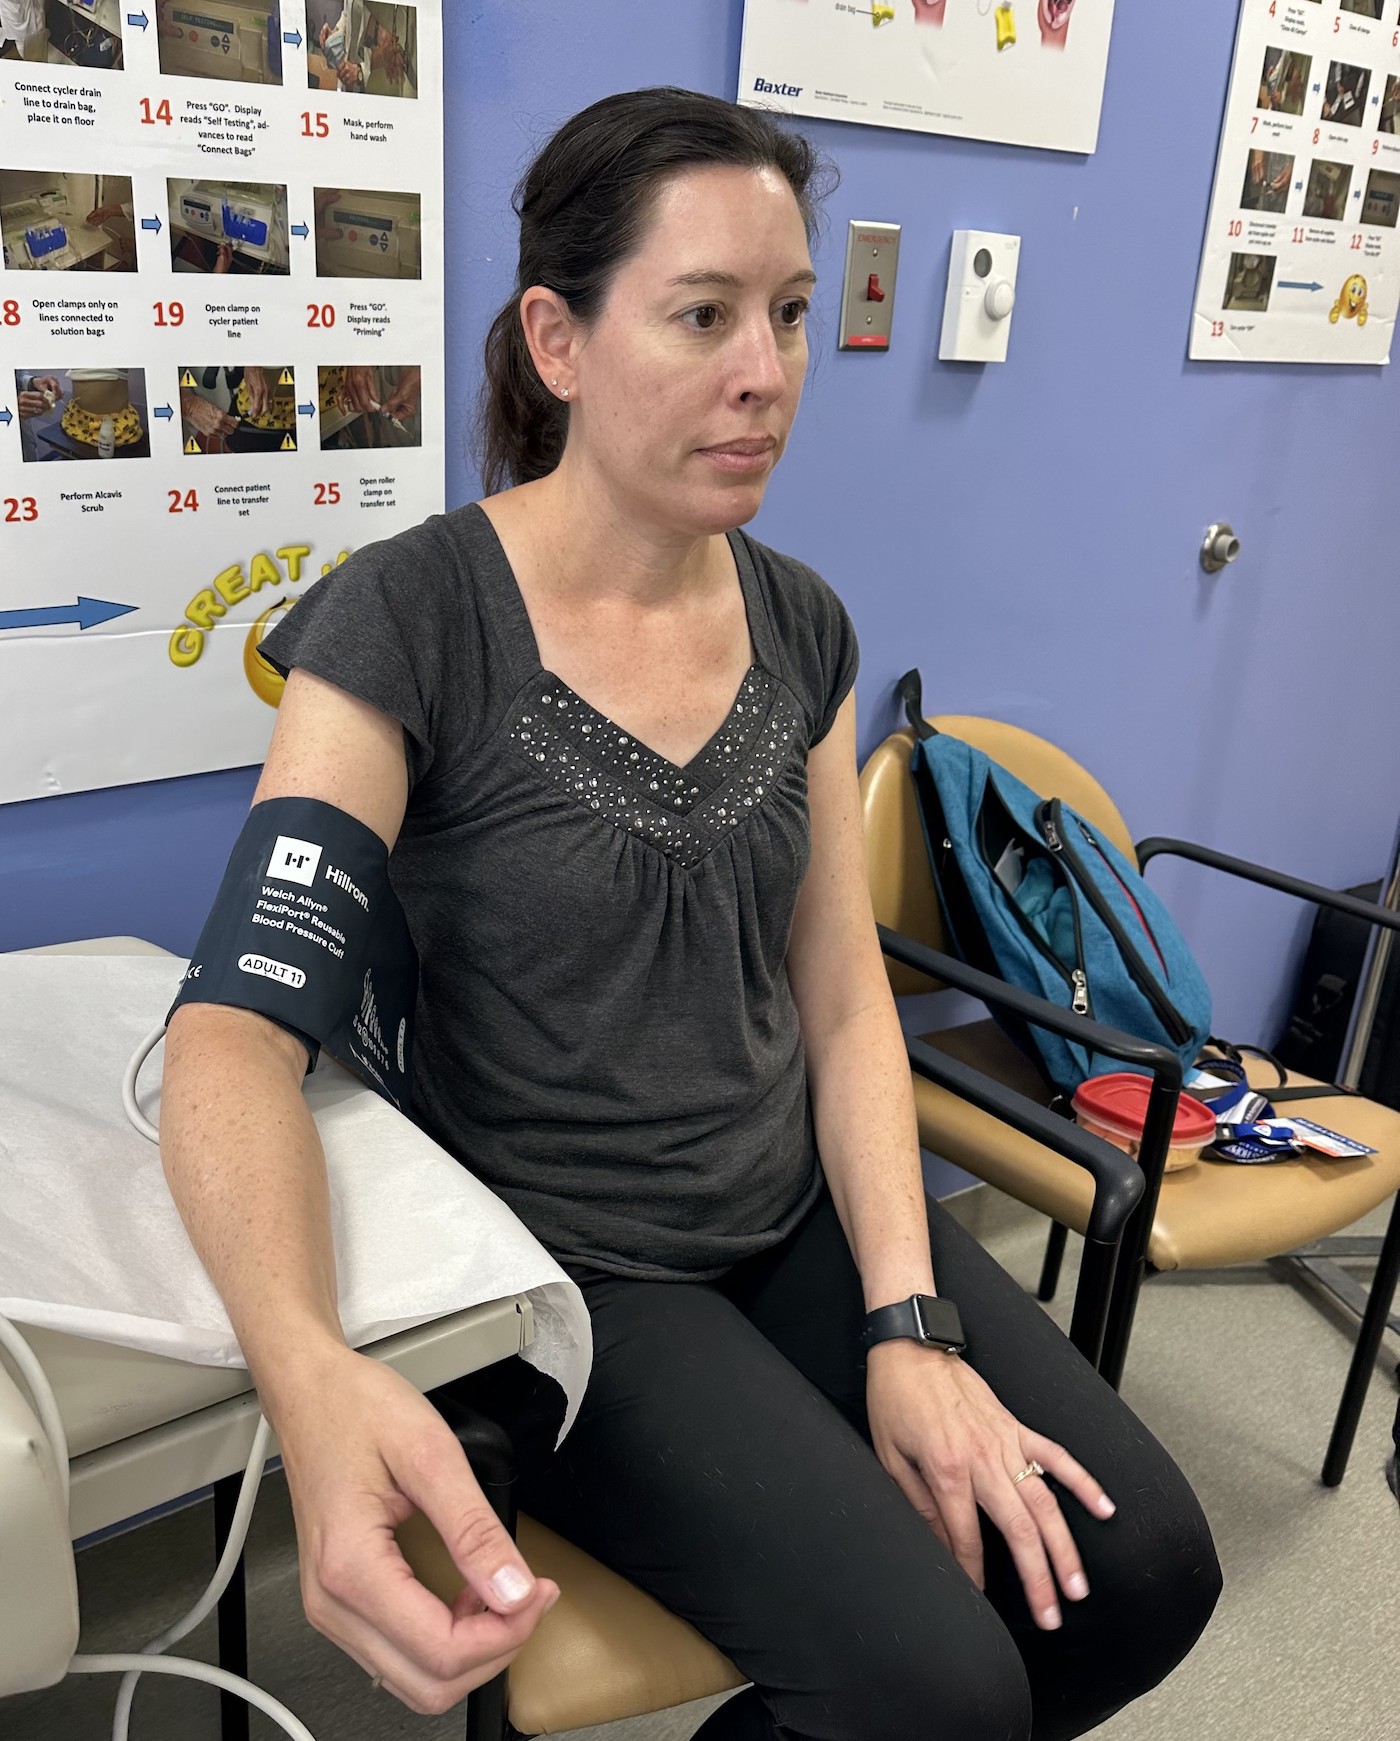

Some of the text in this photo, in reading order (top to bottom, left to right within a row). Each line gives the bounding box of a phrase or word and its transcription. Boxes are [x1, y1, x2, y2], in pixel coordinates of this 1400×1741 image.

[1269, 0, 1276, 17] 4
[1333, 16, 1341, 33] 5
[1392, 31, 1399, 47] 6
[14, 81, 102, 98] Connect cycler drain
[753, 78, 803, 97] Baxter
[23, 97, 96, 113] line to drain bag,
[140, 97, 173, 126] 14
[186, 100, 207, 111] Press
[234, 104, 262, 116] Display
[27, 113, 95, 126] place it on floor
[180, 115, 202, 124] reads
[257, 121, 270, 129] ad-
[300, 112, 329, 138] 15
[343, 118, 394, 130] Mask, perform
[1251, 117, 1259, 134] 7
[198, 131, 253, 142] vances to read
[350, 132, 387, 142] hand wash
[1312, 128, 1320, 144] 8
[197, 144, 256, 157] "Connect Bags"
[1372, 139, 1379, 155] 9
[1228, 220, 1242, 236] 10
[1292, 227, 1304, 243] 11
[1350, 233, 1362, 249] 12
[0, 299, 21, 326] 8
[32, 299, 55, 309] Open
[57, 299, 86, 309] clamps
[88, 300, 106, 310] only
[205, 304, 226, 313] Open
[227, 304, 249, 313] clamp
[350, 303, 368, 311] Press
[39, 313, 114, 322] lines connected to
[153, 301, 184, 326] 19
[307, 304, 335, 328] 20
[347, 316, 371, 324] Display
[209, 318, 258, 326] cycler patient
[1211, 320, 1224, 336] 13
[51, 327, 105, 337] solution bags
[228, 330, 241, 338] line
[353, 328, 385, 337] "Priming"
[214, 484, 271, 493] Connect patient
[360, 478, 377, 486] Open
[60, 490, 122, 501] Perform Alcavis
[168, 489, 199, 513] 24
[217, 496, 269, 505] line to transfer
[314, 482, 341, 505] 25
[363, 489, 382, 497] clamp
[4, 497, 38, 522] 23
[81, 504, 104, 513] Scrub
[360, 500, 385, 508] transfer
[168, 545, 310, 668] GREAT
[262, 885, 296, 902] Welch
[252, 913, 345, 960] Blood Pressure Cuff
[311, 915, 346, 944] Reusable
[243, 958, 302, 984] ADULT 11
